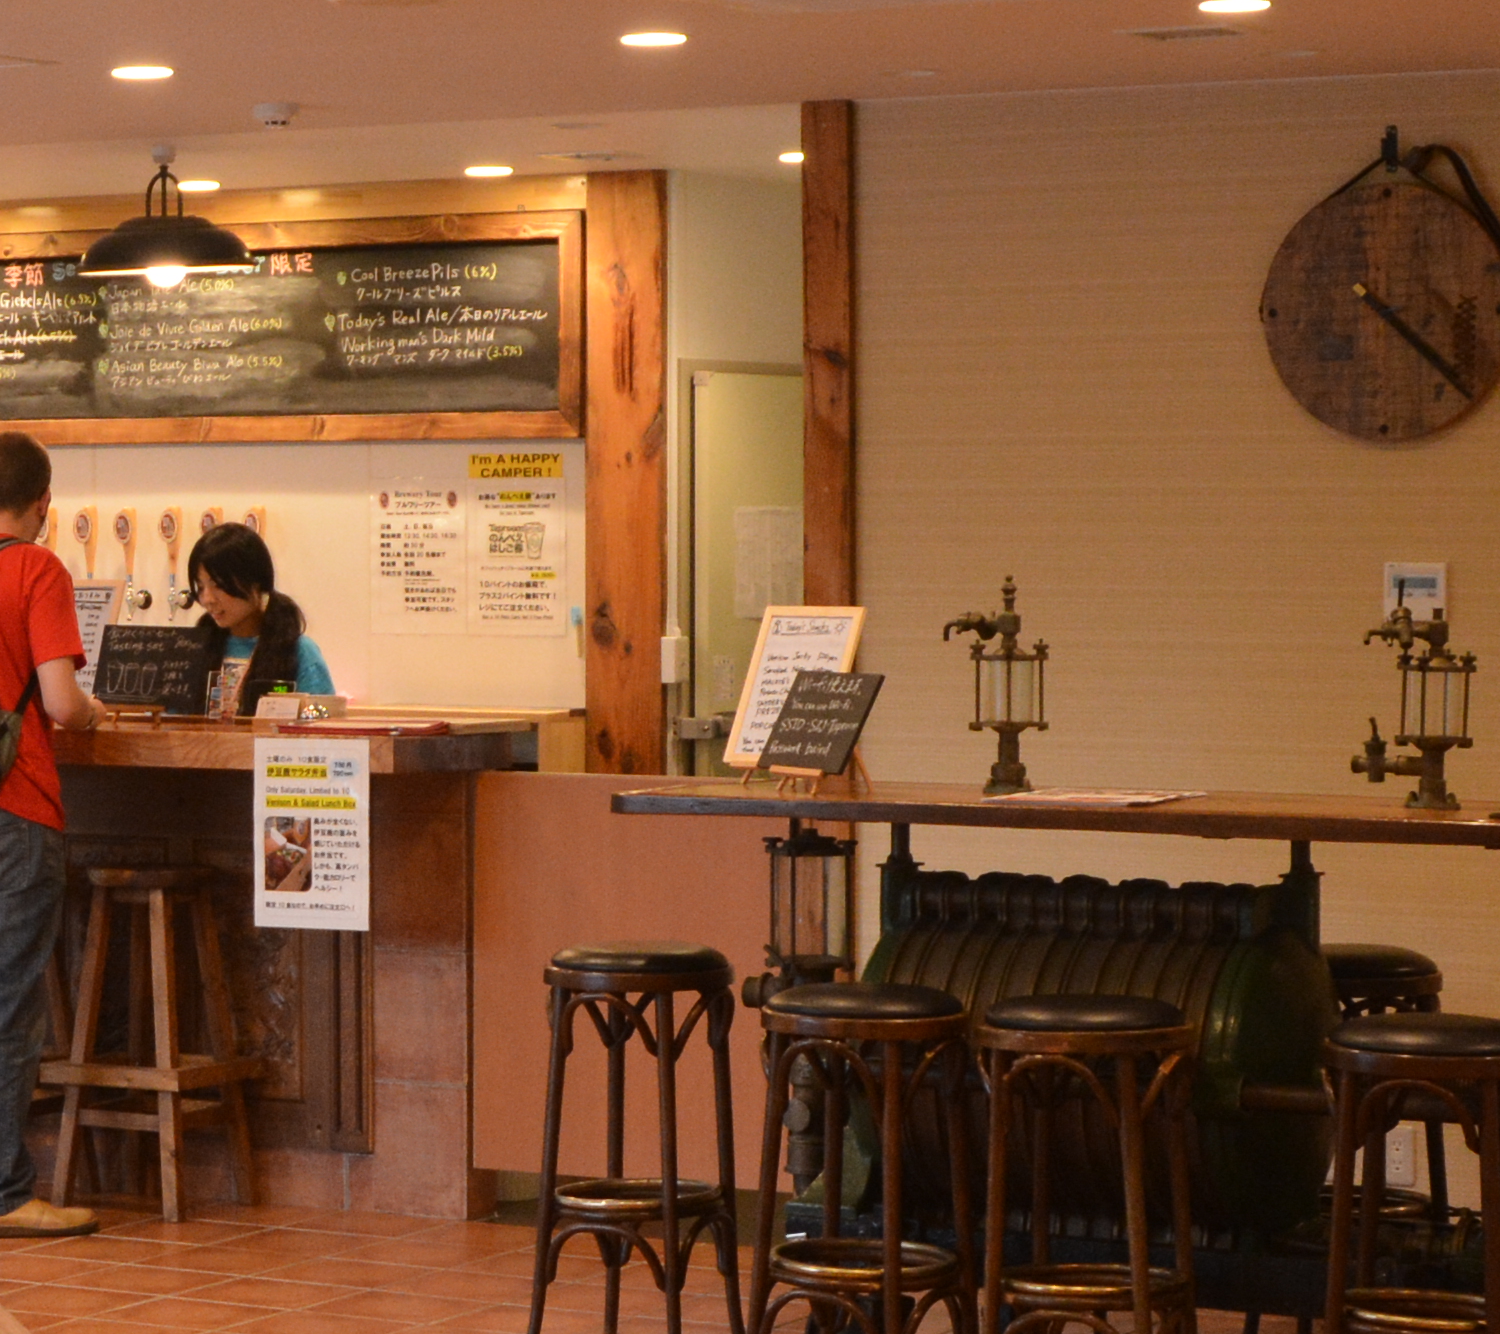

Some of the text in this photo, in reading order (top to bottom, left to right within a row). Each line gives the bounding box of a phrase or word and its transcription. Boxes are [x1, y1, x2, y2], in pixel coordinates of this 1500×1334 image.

[270, 252, 314, 275] 限定
[351, 268, 378, 282] Cool
[384, 267, 429, 281] Breeze
[431, 263, 460, 281] Pils
[4, 263, 45, 287] 季節
[472, 453, 560, 464] I'm A HAPPY
[480, 467, 543, 478] CAMPER
